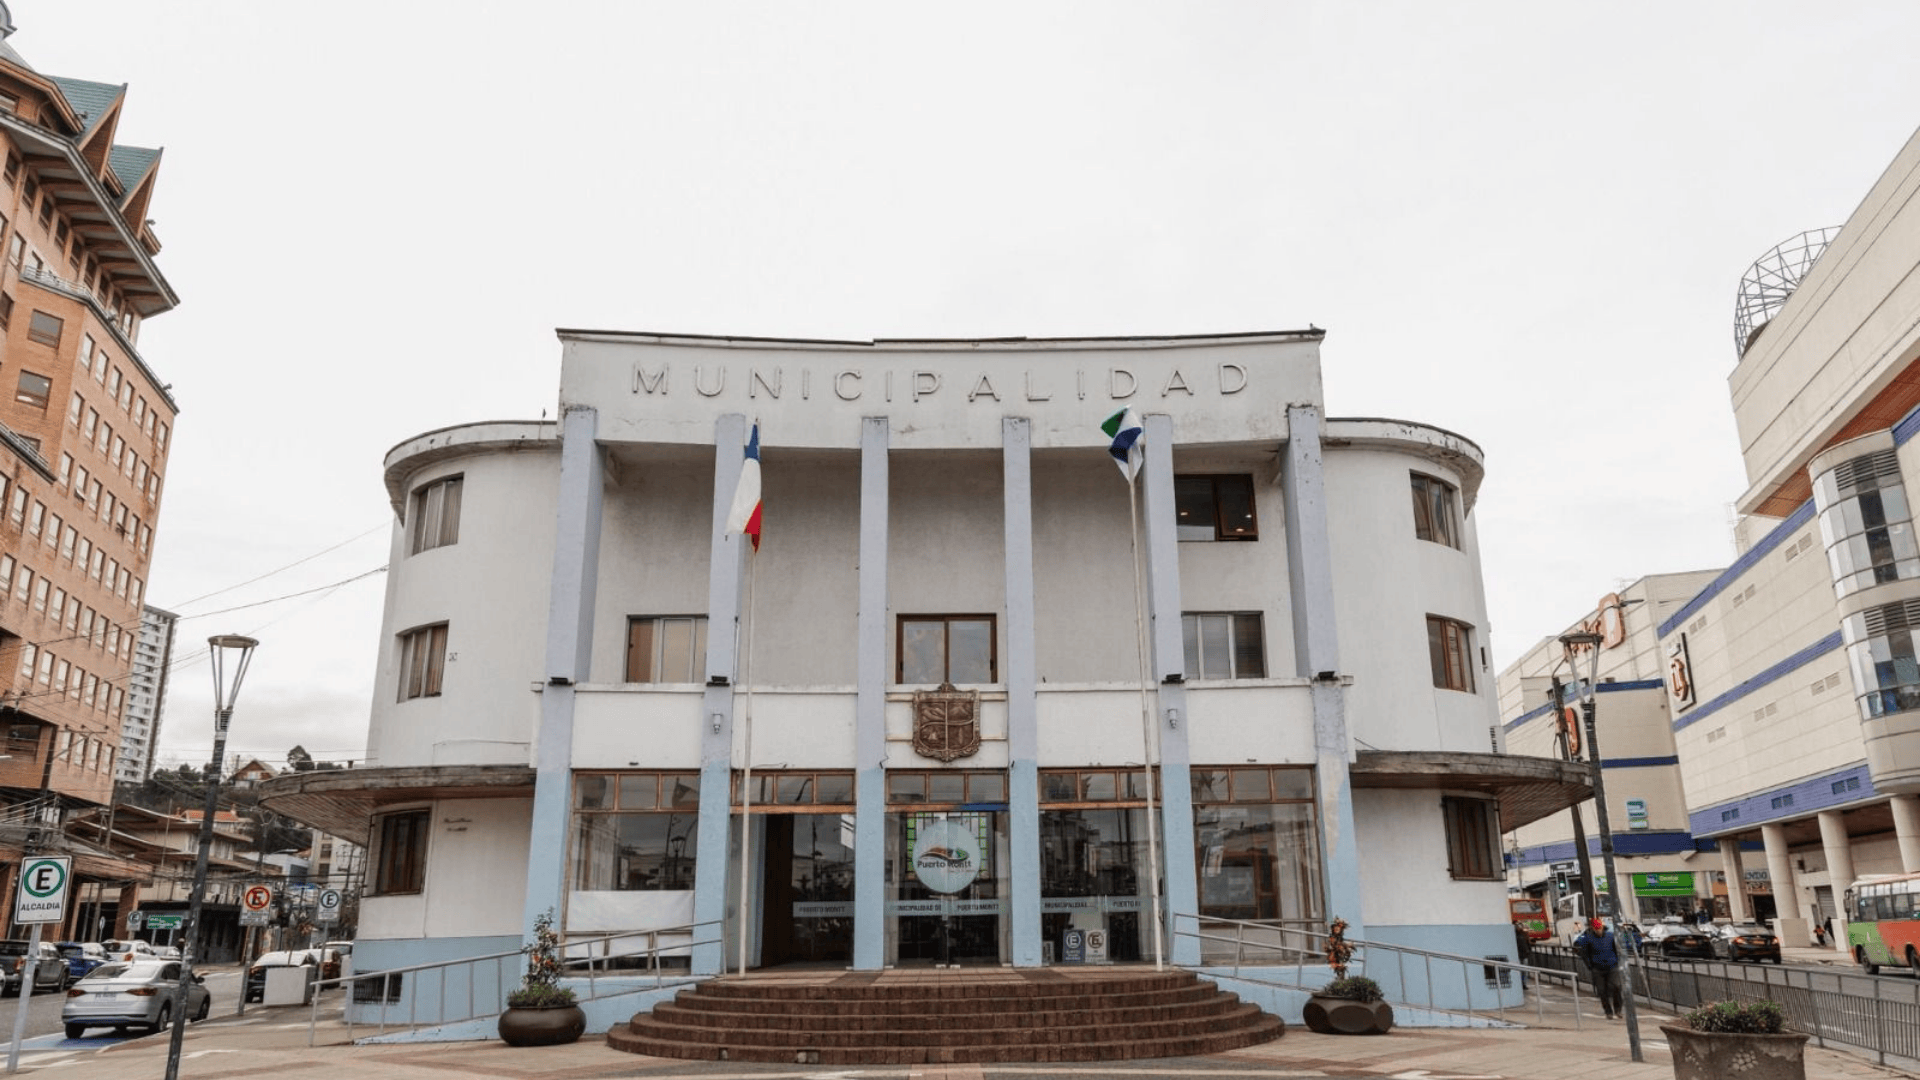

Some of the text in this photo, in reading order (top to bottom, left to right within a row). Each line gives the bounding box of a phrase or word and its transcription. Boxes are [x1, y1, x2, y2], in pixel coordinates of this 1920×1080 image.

[633, 361, 1248, 402] MUNICIPALIDAD
[917, 860, 946, 869] Puerto
[36, 868, 53, 890] E
[21, 902, 60, 911] ALCALDIA
